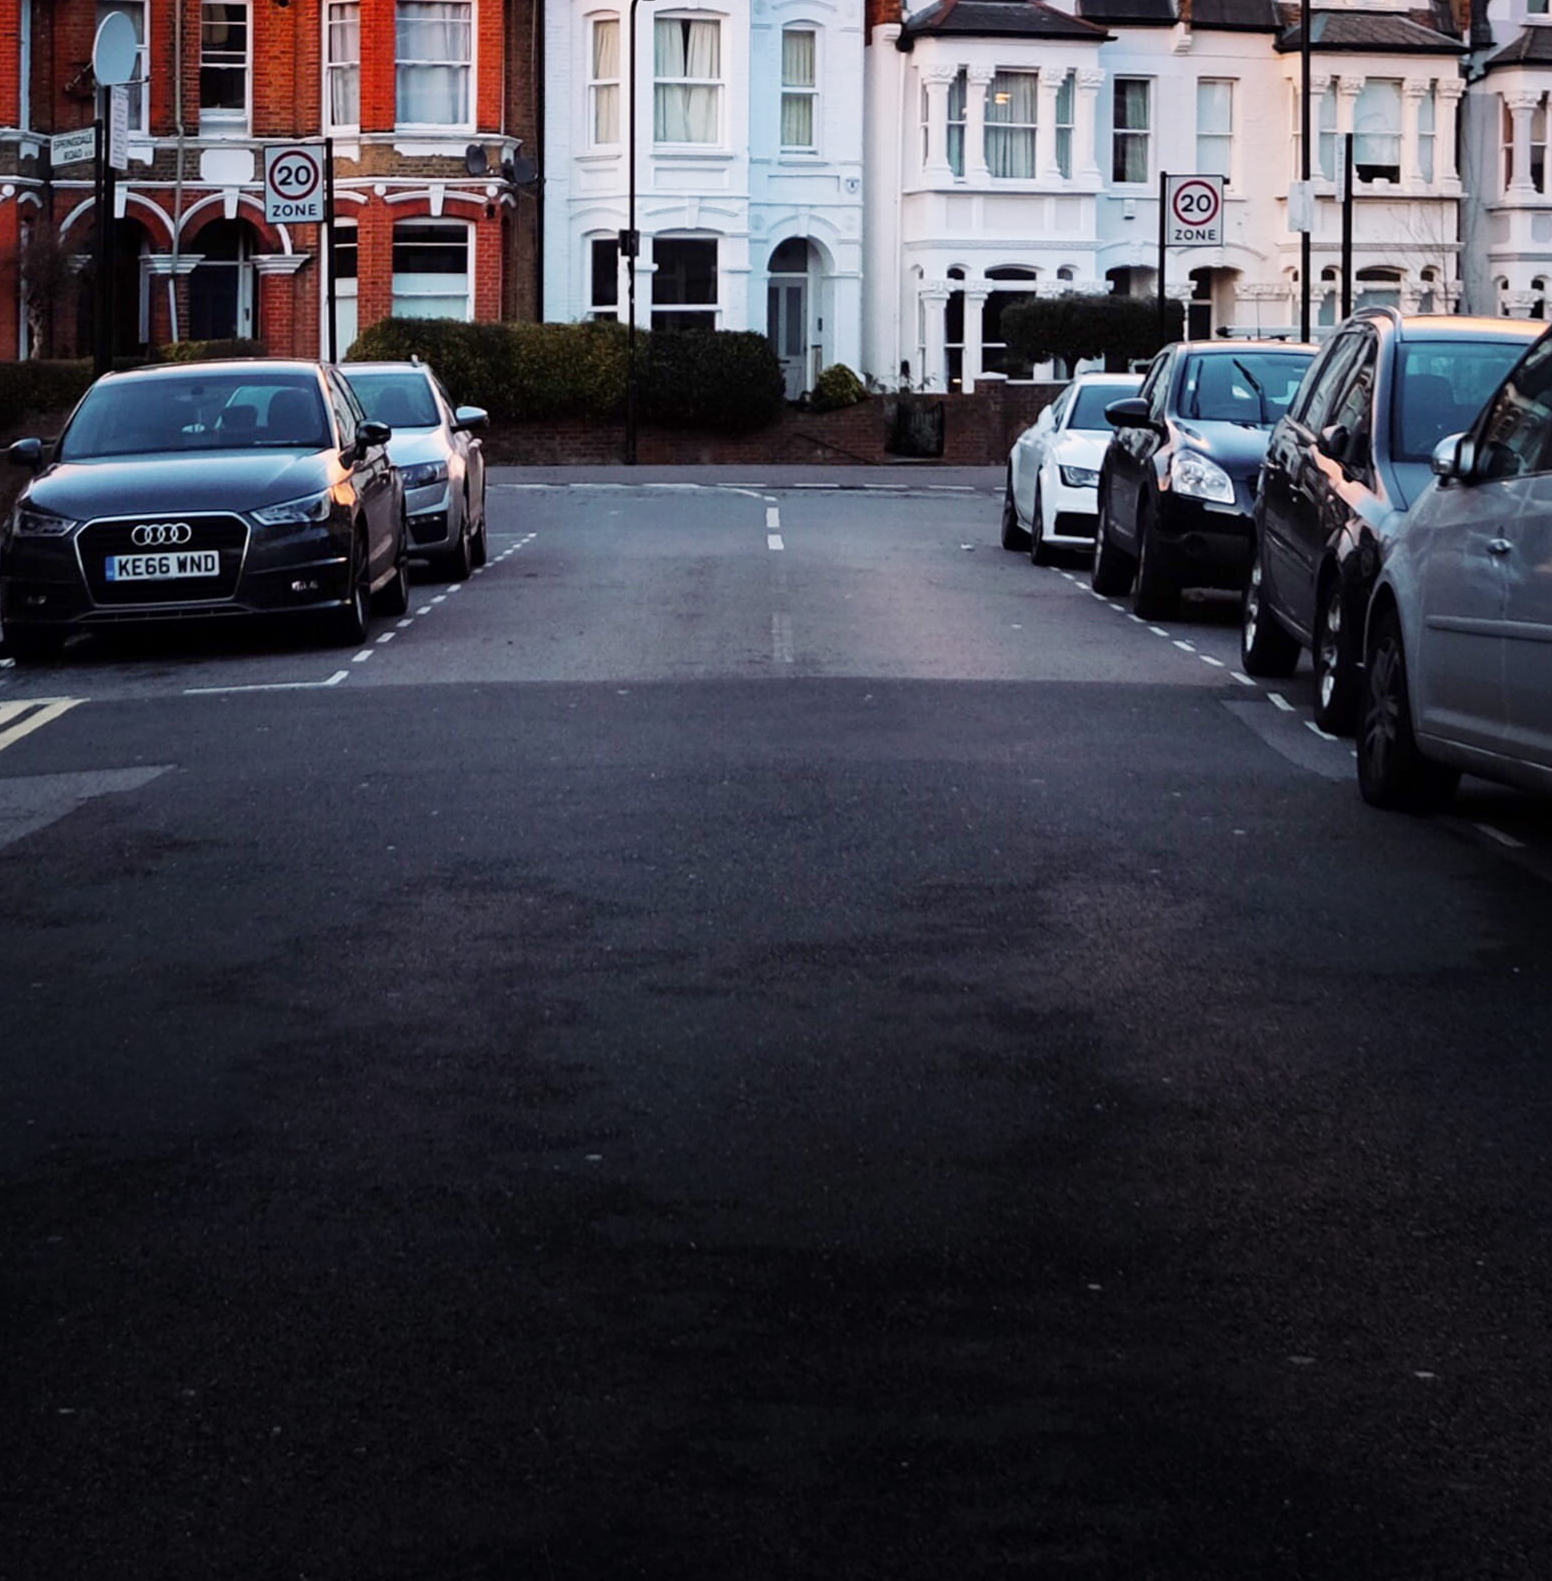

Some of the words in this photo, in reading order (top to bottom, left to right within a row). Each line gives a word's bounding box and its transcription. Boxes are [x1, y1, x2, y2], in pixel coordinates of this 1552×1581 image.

[64, 149, 82, 160] ROAD
[277, 165, 311, 186] 20
[272, 204, 317, 217] ZONE
[1180, 194, 1212, 213] 20
[1175, 229, 1216, 240] ZONE
[118, 556, 170, 577] KE66
[176, 554, 216, 573] WND
